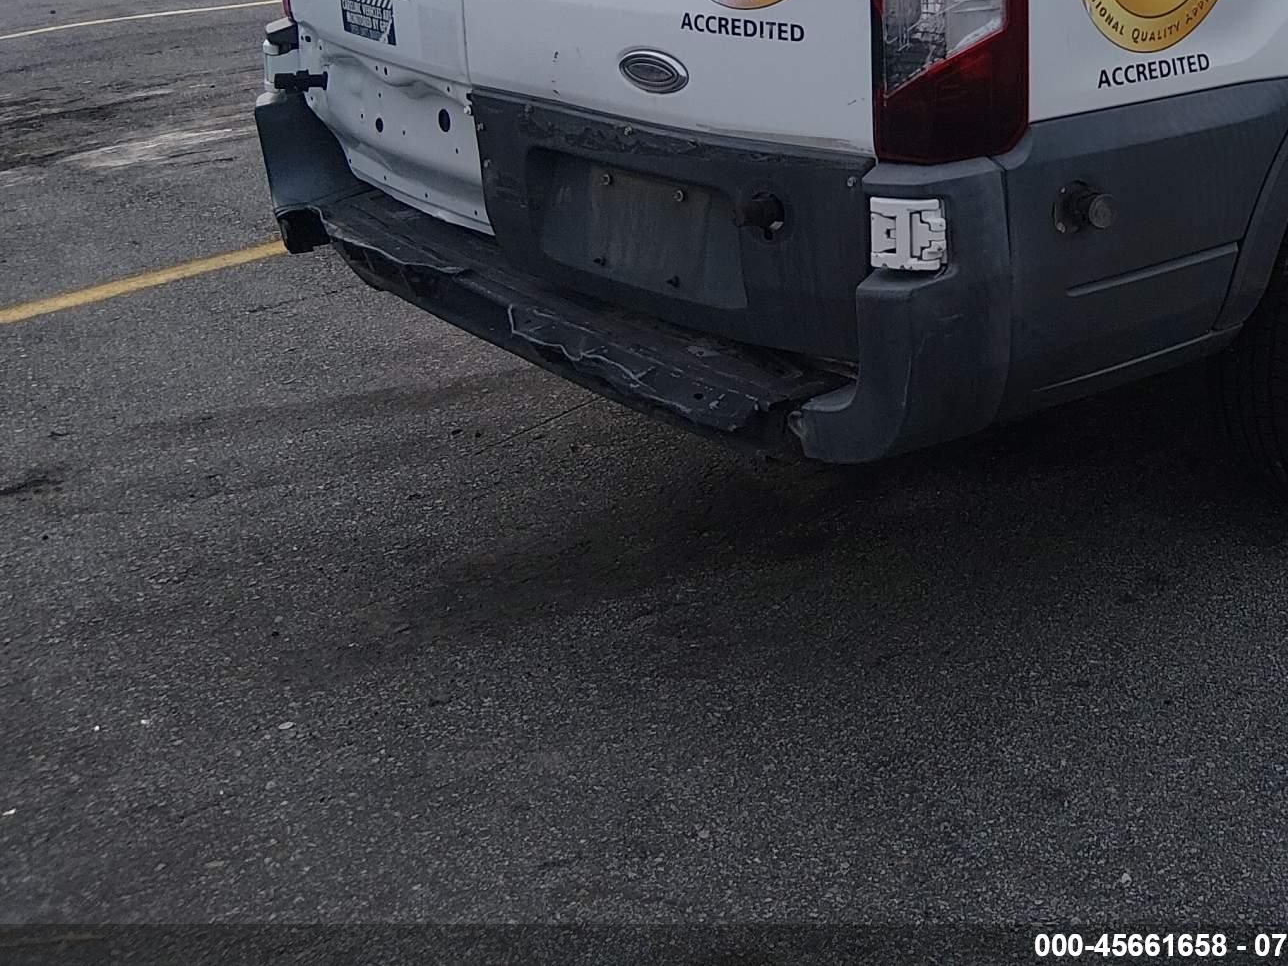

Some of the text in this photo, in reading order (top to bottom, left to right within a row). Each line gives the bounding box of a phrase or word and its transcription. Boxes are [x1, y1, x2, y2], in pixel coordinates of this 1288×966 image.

[680, 12, 806, 43] ACCREDITED
[1131, 21, 1181, 44] QUALITY
[1097, 53, 1211, 90] ACCREDITED
